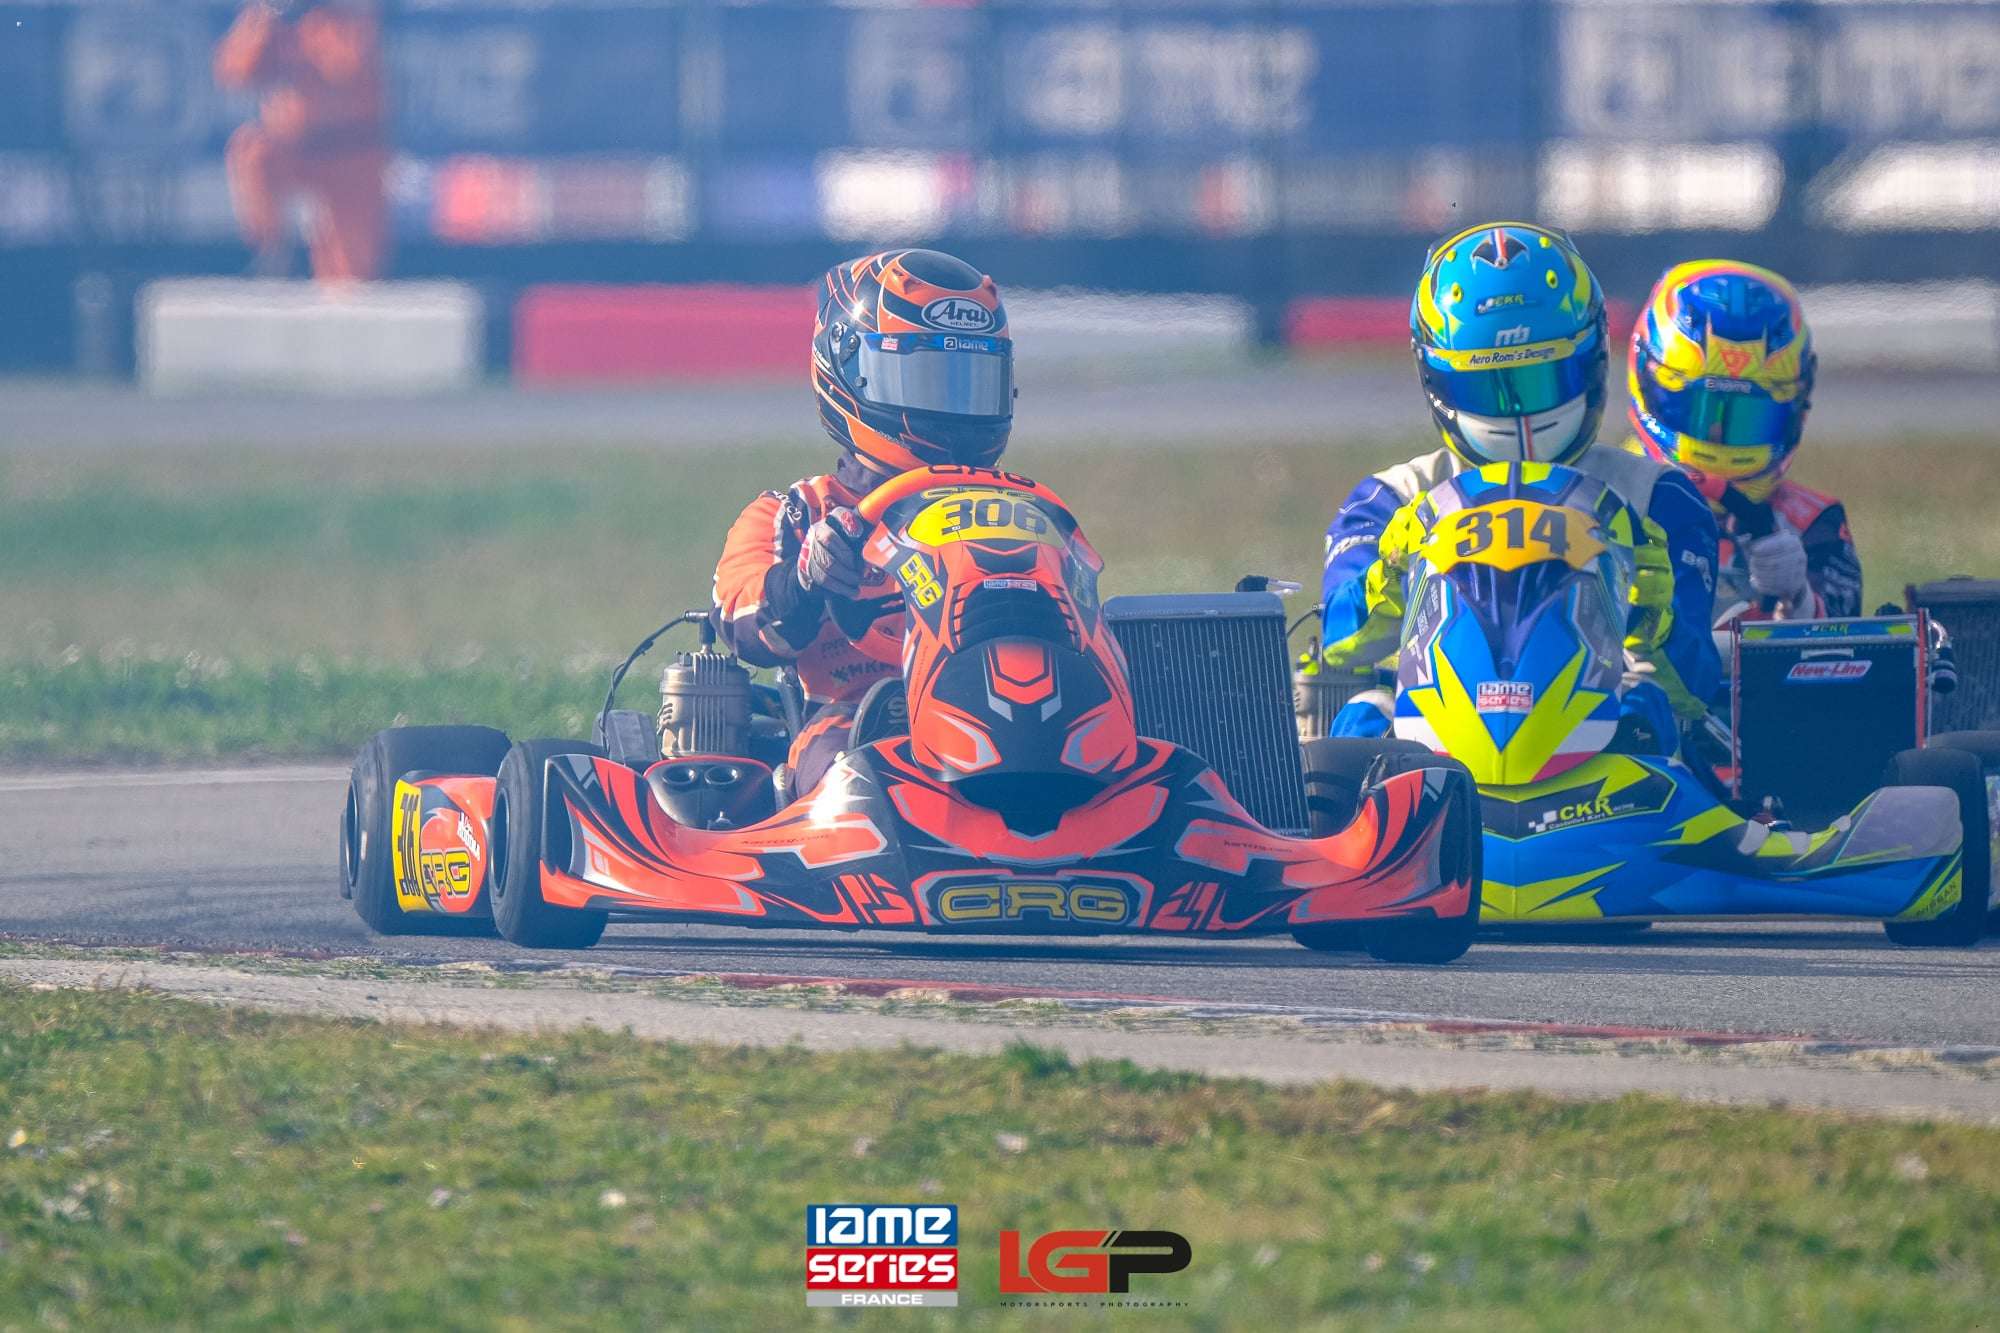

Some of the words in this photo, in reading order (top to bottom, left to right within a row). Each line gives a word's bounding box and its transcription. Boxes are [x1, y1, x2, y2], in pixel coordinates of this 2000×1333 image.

[931, 301, 988, 322] Arai
[1470, 353, 1491, 365] Aero
[942, 498, 1047, 535] 306
[1456, 508, 1571, 560] 314
[897, 552, 944, 610] CRG
[1791, 662, 1867, 677] New-Line
[1478, 696, 1532, 711] series
[1559, 797, 1614, 820] CKR
[421, 853, 471, 896] CRG
[939, 884, 1130, 921] CRG
